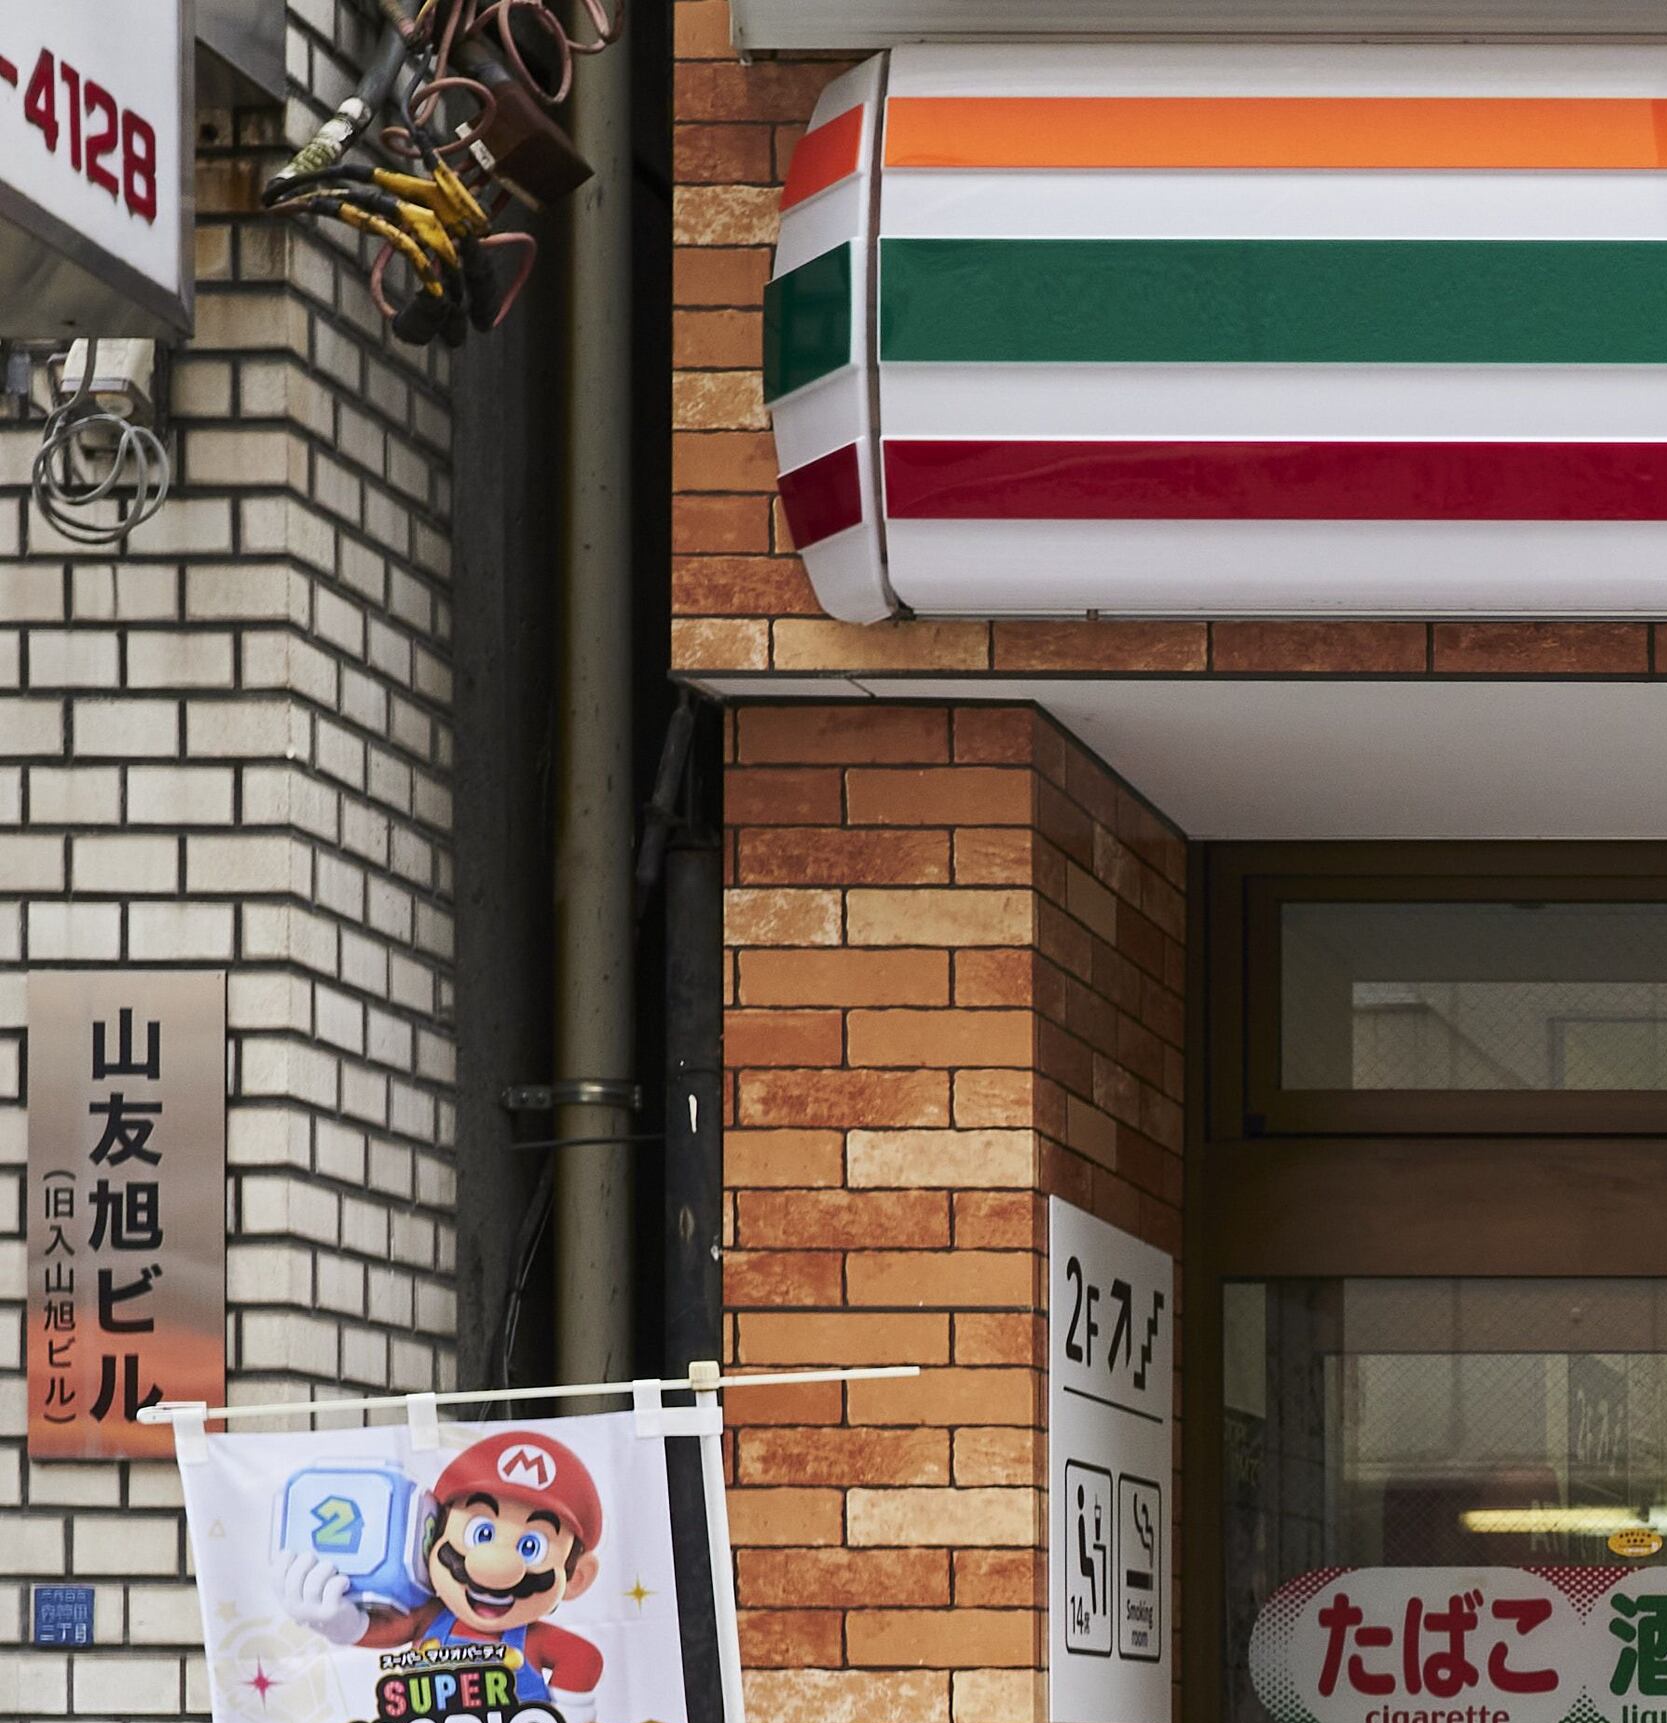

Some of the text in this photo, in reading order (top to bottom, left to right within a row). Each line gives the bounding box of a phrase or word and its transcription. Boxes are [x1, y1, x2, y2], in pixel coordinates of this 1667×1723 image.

[88, 1007, 163, 1424] 山友旭ビル
[1065, 1255, 1100, 1367] 2F
[309, 1495, 365, 1554] 2
[1126, 1597, 1154, 1631] Smoking
[1317, 1588, 1559, 1697] たばこ
[383, 1670, 510, 1716] SUPER
